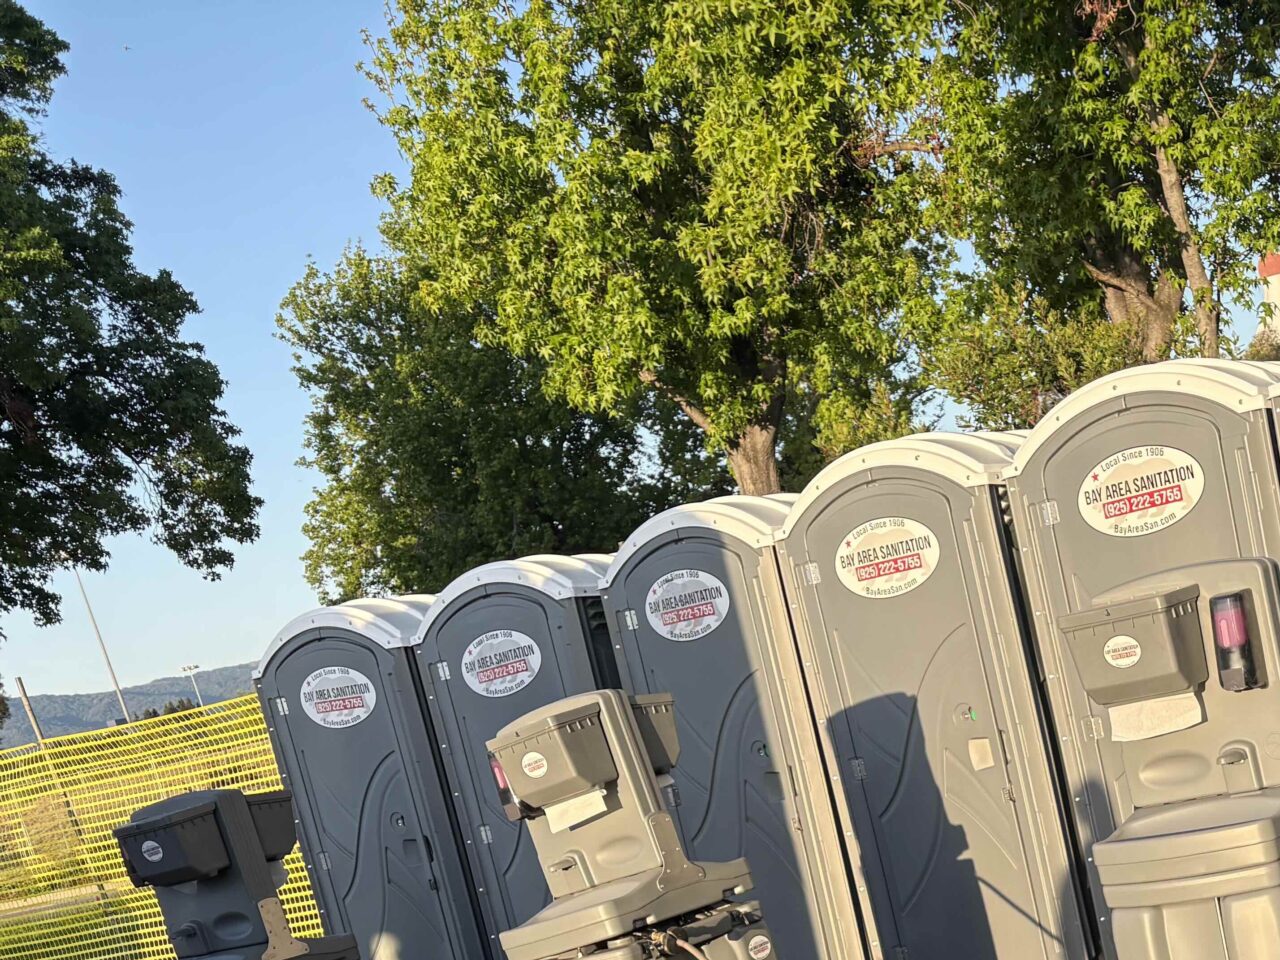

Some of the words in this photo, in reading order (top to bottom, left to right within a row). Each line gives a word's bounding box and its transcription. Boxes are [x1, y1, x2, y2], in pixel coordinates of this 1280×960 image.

[1101, 456, 1120, 472] Local
[1122, 450, 1142, 461] Since
[1146, 448, 1164, 456] 1906
[1084, 488, 1102, 505] BAY
[1106, 481, 1132, 500] AREA
[1133, 464, 1194, 492] SANITATION
[1105, 501, 1129, 517] (925)
[1132, 487, 1181, 510] 222-5755
[853, 526, 868, 539] Local
[869, 520, 886, 530] Since
[889, 519, 905, 527] 1906
[1114, 512, 1176, 535] BayAreaSan.com
[840, 554, 856, 568] BAY
[858, 548, 879, 565] AREA
[880, 535, 931, 560] SANITATION
[858, 566, 878, 580] (925)
[880, 556, 920, 574] 222-5755
[866, 578, 917, 596] BayAreaSan.com
[649, 600, 661, 614] BAY
[662, 596, 679, 610] AREA
[679, 586, 722, 606] SANITATION
[680, 604, 713, 620] 222-5755
[485, 633, 499, 641] Since
[464, 660, 476, 673] BAY
[477, 655, 494, 670] AREA
[494, 644, 535, 664] SANITATION
[496, 661, 526, 677] 222-5755
[311, 672, 323, 681] Local
[303, 691, 314, 702] BAY
[316, 689, 331, 700] AREA
[332, 683, 370, 698] SANITATION
[332, 699, 362, 710] 222-5755
